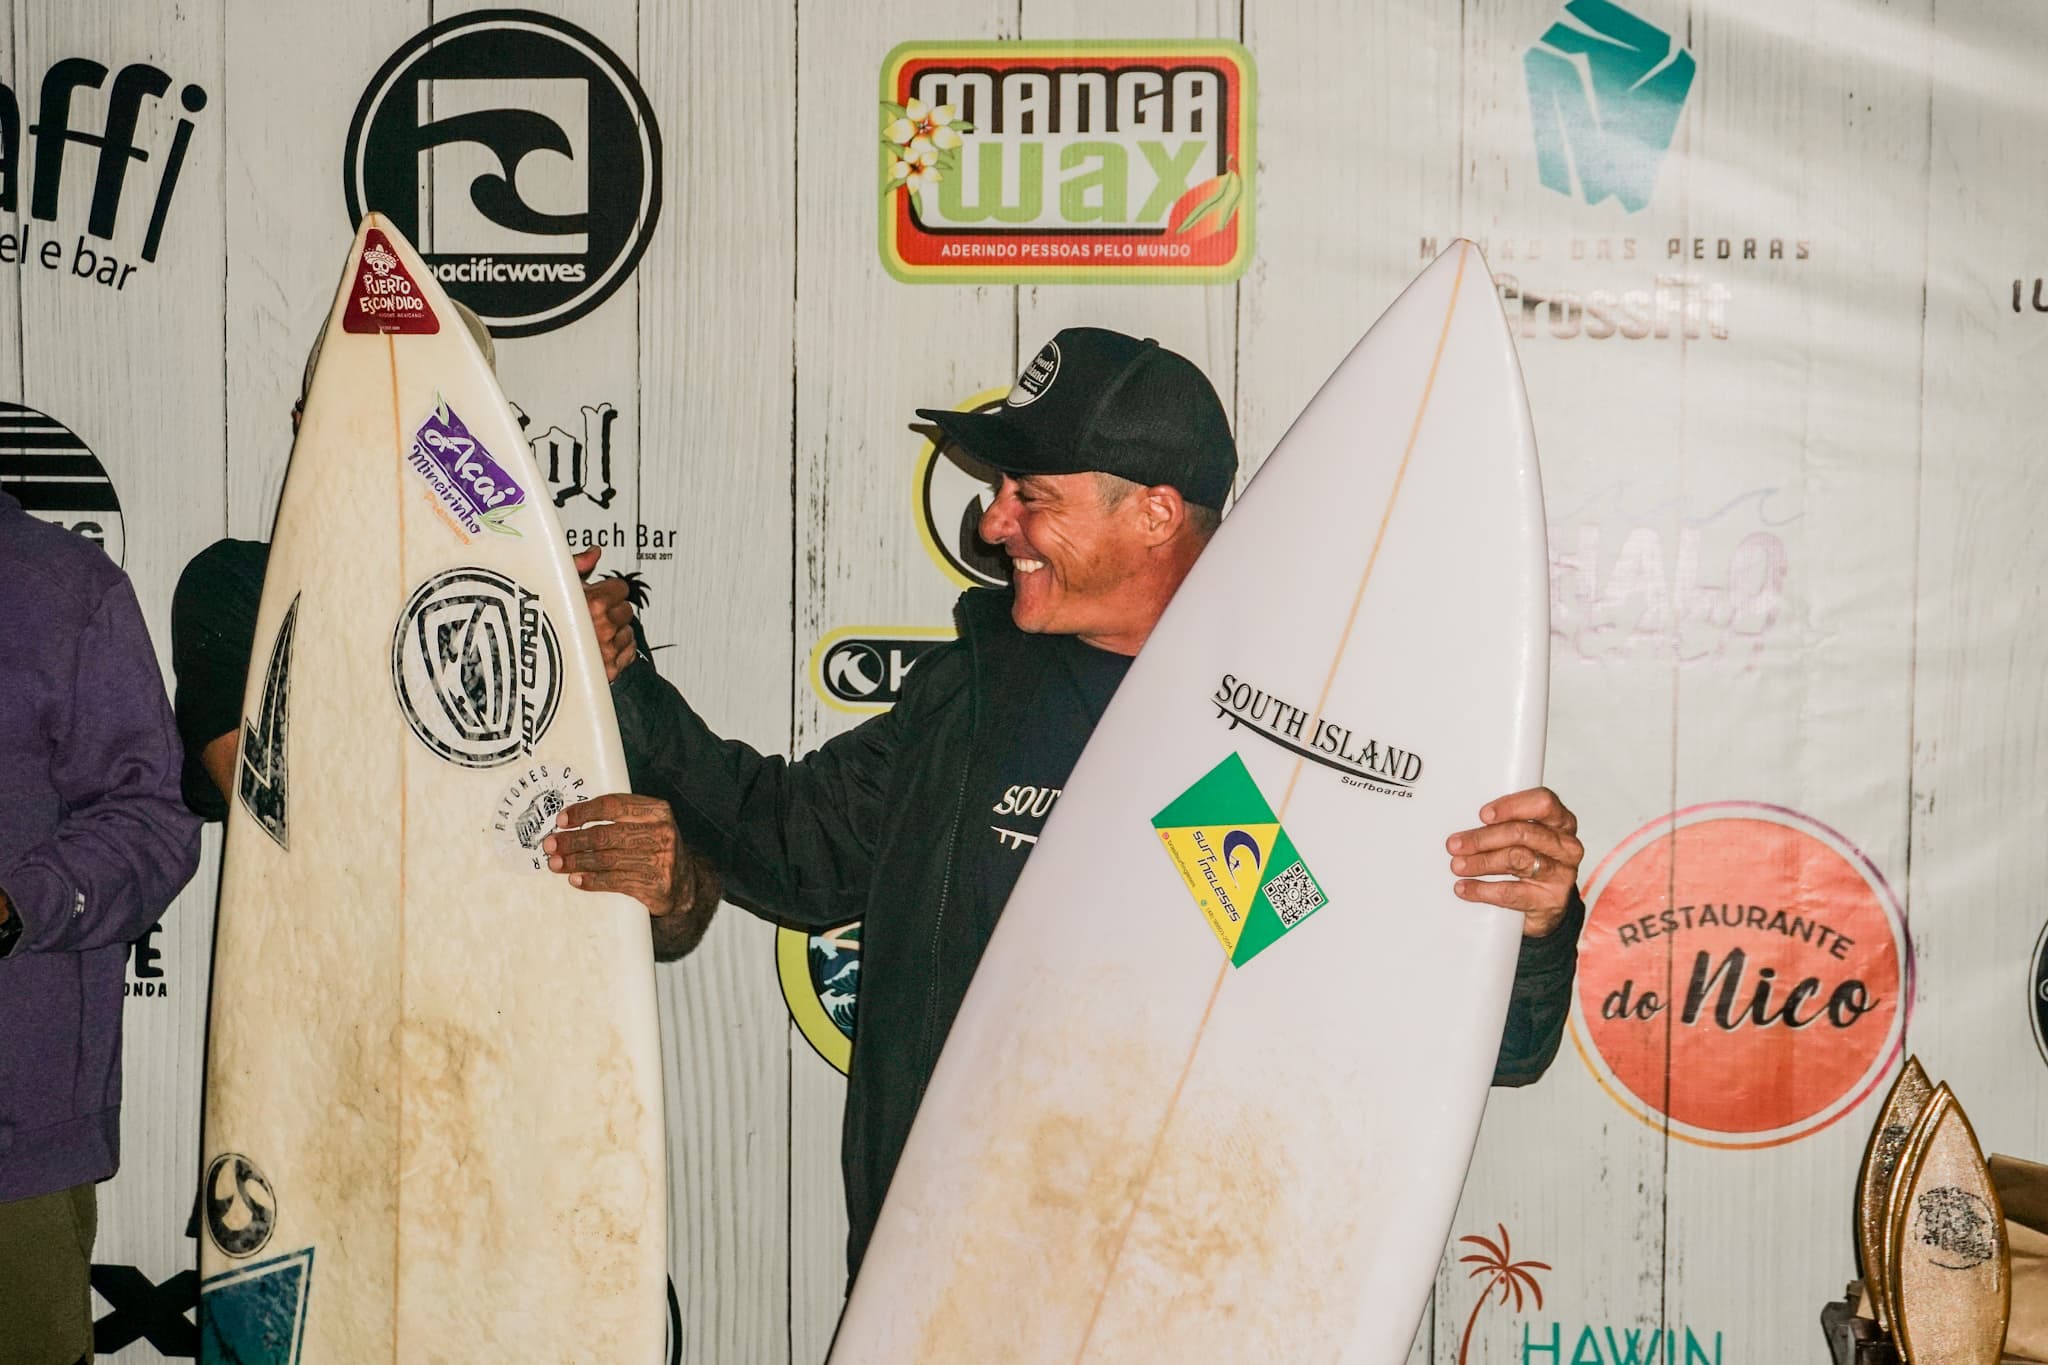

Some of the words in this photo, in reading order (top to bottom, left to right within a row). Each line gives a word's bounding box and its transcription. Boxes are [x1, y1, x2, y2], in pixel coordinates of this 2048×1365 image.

[918, 72, 1219, 134] MANGA
[72, 236, 137, 291] bar
[941, 244, 1017, 257] ADERINDO
[1021, 244, 1089, 257] PESSOAS
[1094, 243, 1132, 257] PELO
[1137, 243, 1190, 257] MUNDO
[1667, 238, 1811, 260] PEDRAS
[363, 273, 411, 294] PUERTO
[360, 295, 423, 314] ESCONDIDO
[408, 444, 481, 534] Mineirinho
[566, 522, 625, 548] each
[636, 524, 677, 548] Bar
[521, 694, 535, 756] HOT
[1215, 674, 1309, 741] SOUTH
[1310, 718, 1424, 783] ISLAND
[563, 766, 589, 802] CRA
[992, 785, 1062, 818] SOU
[1340, 775, 1413, 798] Surfboards
[1617, 903, 1855, 961] RESTAURANTE
[1602, 979, 1668, 1021] do
[1680, 947, 1880, 1032] Nico
